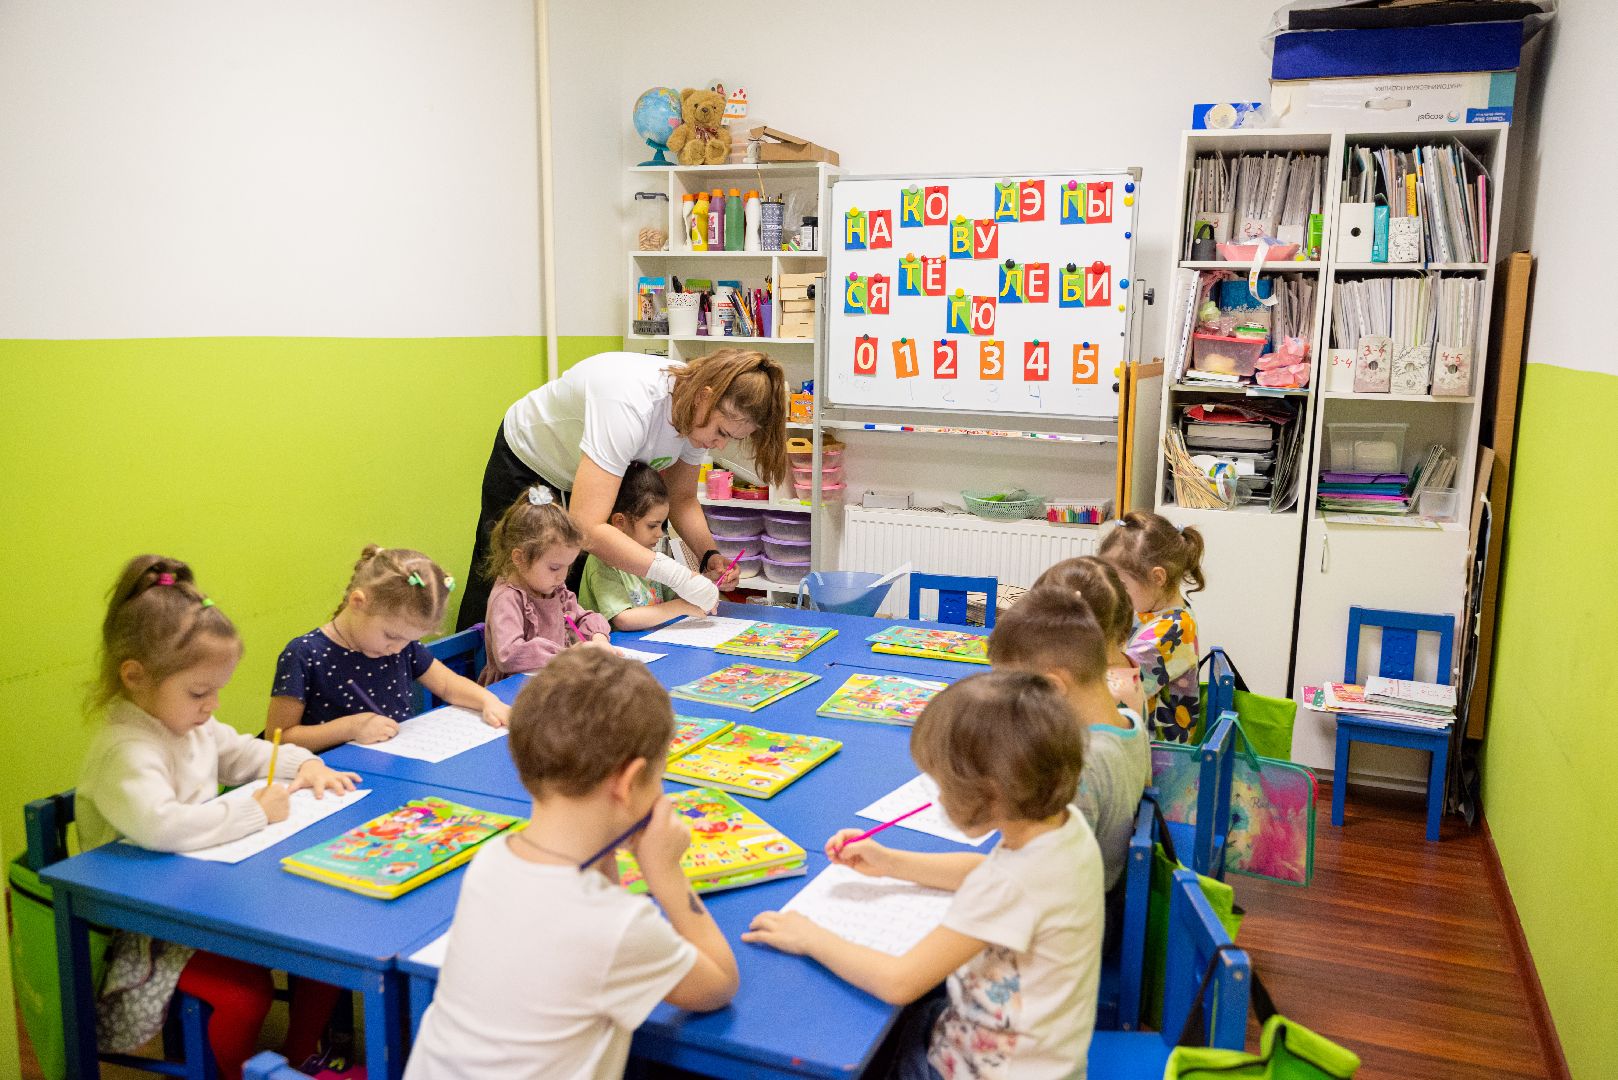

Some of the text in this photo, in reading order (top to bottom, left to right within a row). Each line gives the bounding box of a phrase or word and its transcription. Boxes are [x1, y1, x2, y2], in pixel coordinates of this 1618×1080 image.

[1417, 112, 1445, 122] ecogel
[903, 191, 947, 222] КО
[995, 187, 1041, 219] ДЭ
[1062, 188, 1111, 218] ПЫ
[846, 216, 891, 244] НА
[953, 224, 997, 254] ВУ
[901, 258, 942, 290] ТЁ
[1000, 268, 1045, 297] ЛЕ
[1062, 271, 1109, 301] БИ
[846, 281, 888, 308] СЯ
[950, 301, 996, 330] ГЮ
[857, 342, 1096, 379] 0 1 2 3 4 5
[1332, 355, 1353, 369] 3-4
[1441, 351, 1463, 363] 4-5
